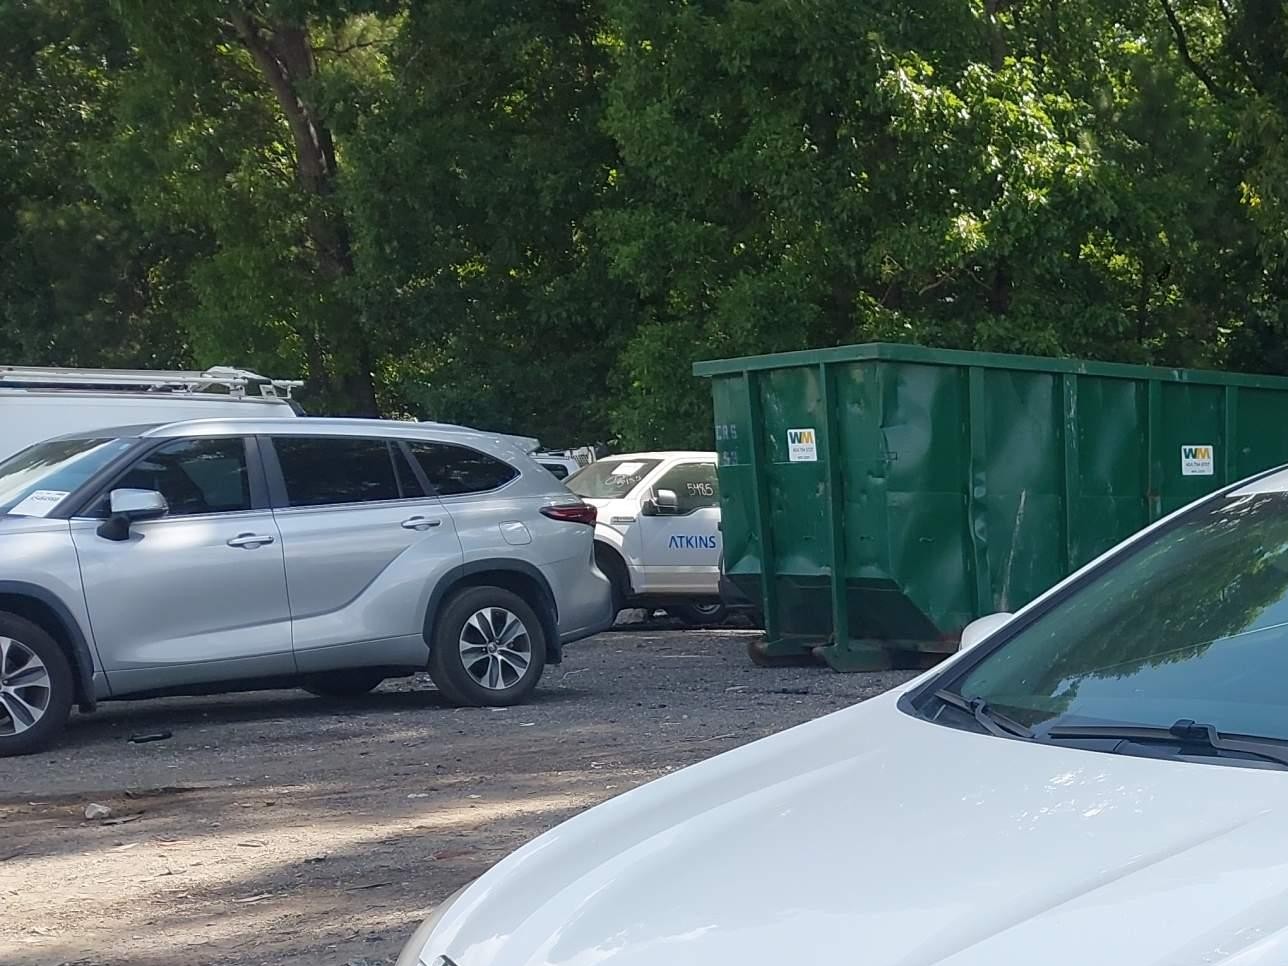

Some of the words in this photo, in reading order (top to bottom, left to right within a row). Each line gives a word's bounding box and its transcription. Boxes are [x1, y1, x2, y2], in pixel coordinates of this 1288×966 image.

[788, 431, 814, 444] WM
[1183, 447, 1210, 460] WM
[669, 535, 716, 548] ATKINS
